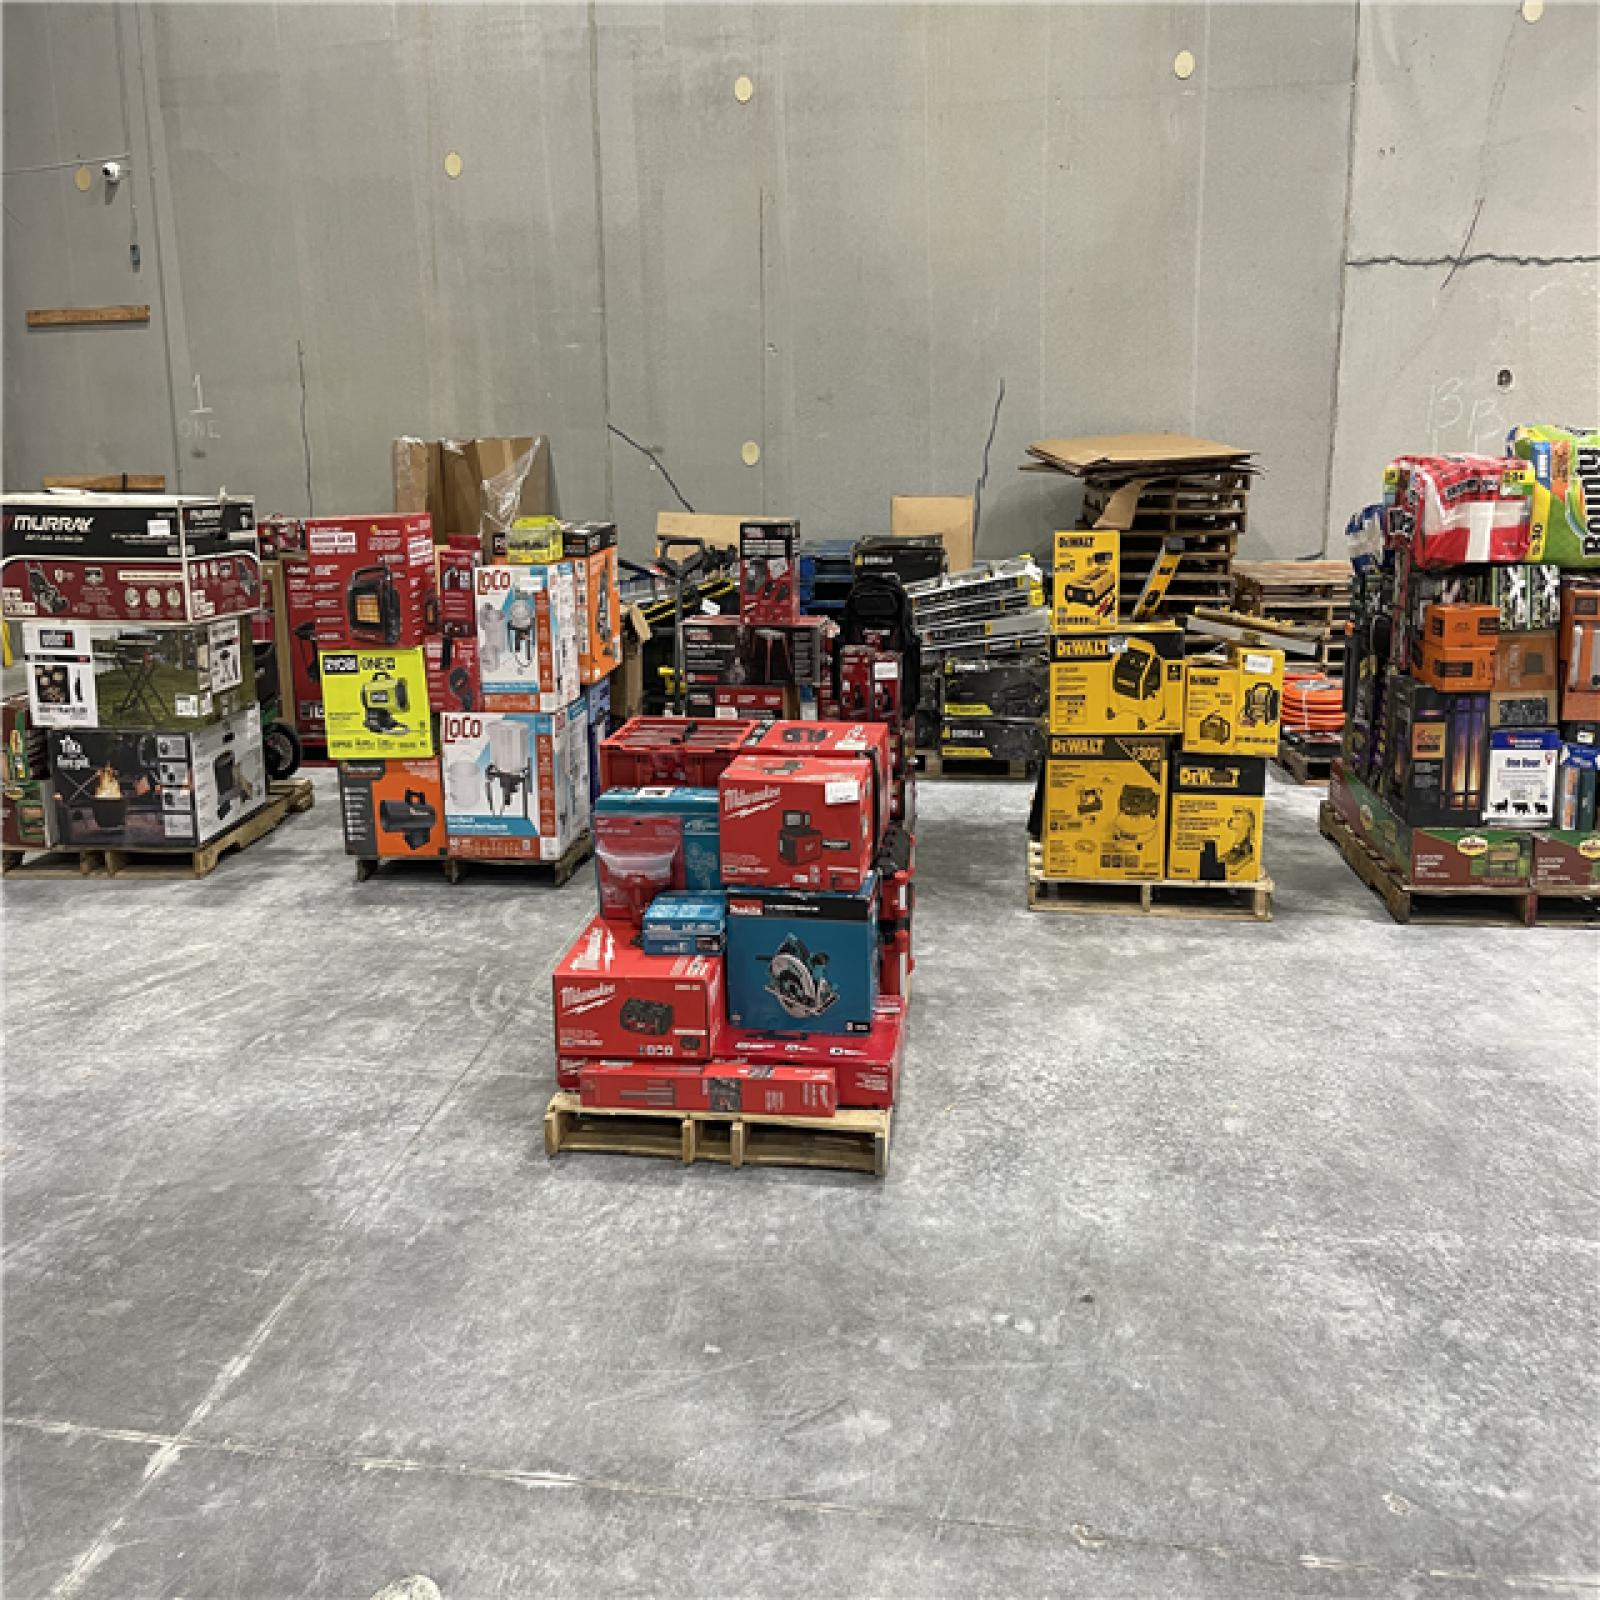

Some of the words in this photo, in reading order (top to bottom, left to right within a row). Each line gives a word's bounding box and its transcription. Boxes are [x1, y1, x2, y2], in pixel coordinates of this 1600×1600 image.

[14, 514, 95, 532] MURRAY
[324, 657, 357, 671] RYOBI
[723, 784, 781, 811] Milwaukee
[560, 983, 616, 1009] Milwaukee
